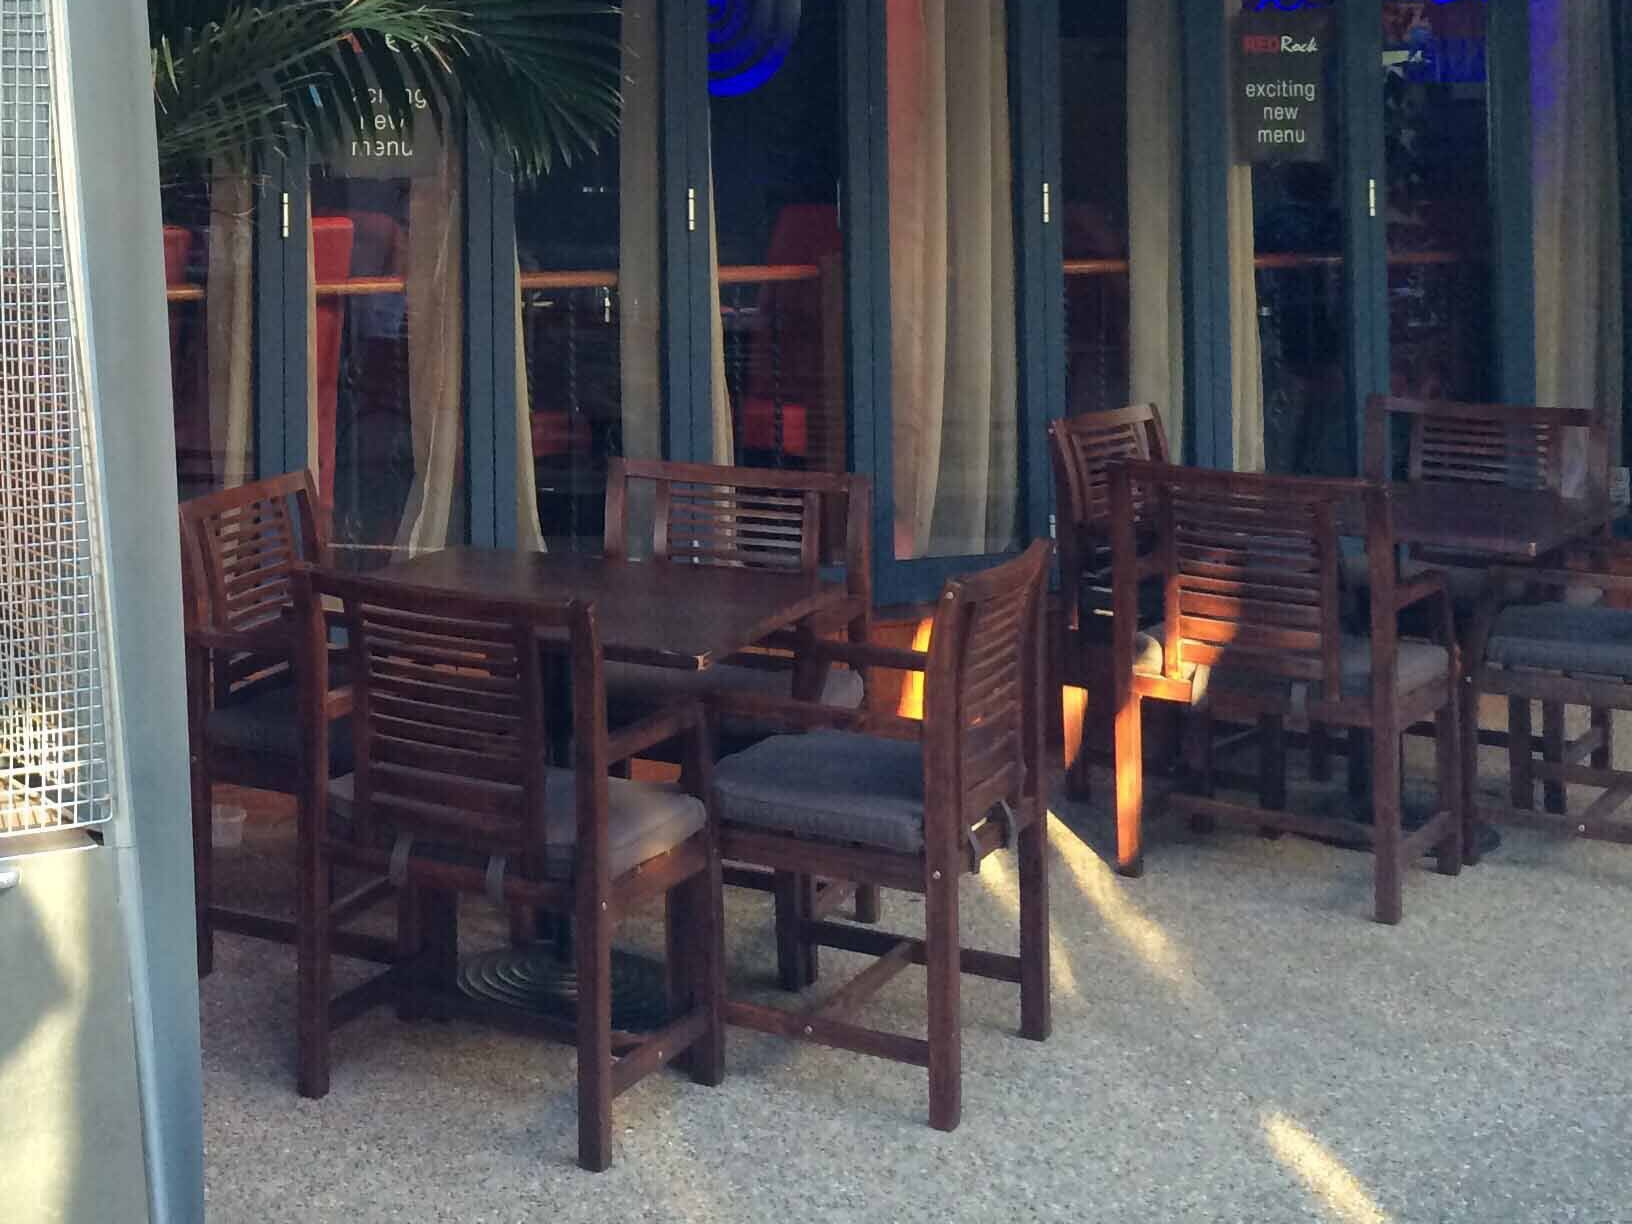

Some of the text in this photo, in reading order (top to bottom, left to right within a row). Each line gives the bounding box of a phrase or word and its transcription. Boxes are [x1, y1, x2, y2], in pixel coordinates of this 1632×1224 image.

[1280, 35, 1319, 52] Rock
[1246, 79, 1316, 101] exciting
[1263, 106, 1299, 120] new
[1257, 128, 1305, 143] menu
